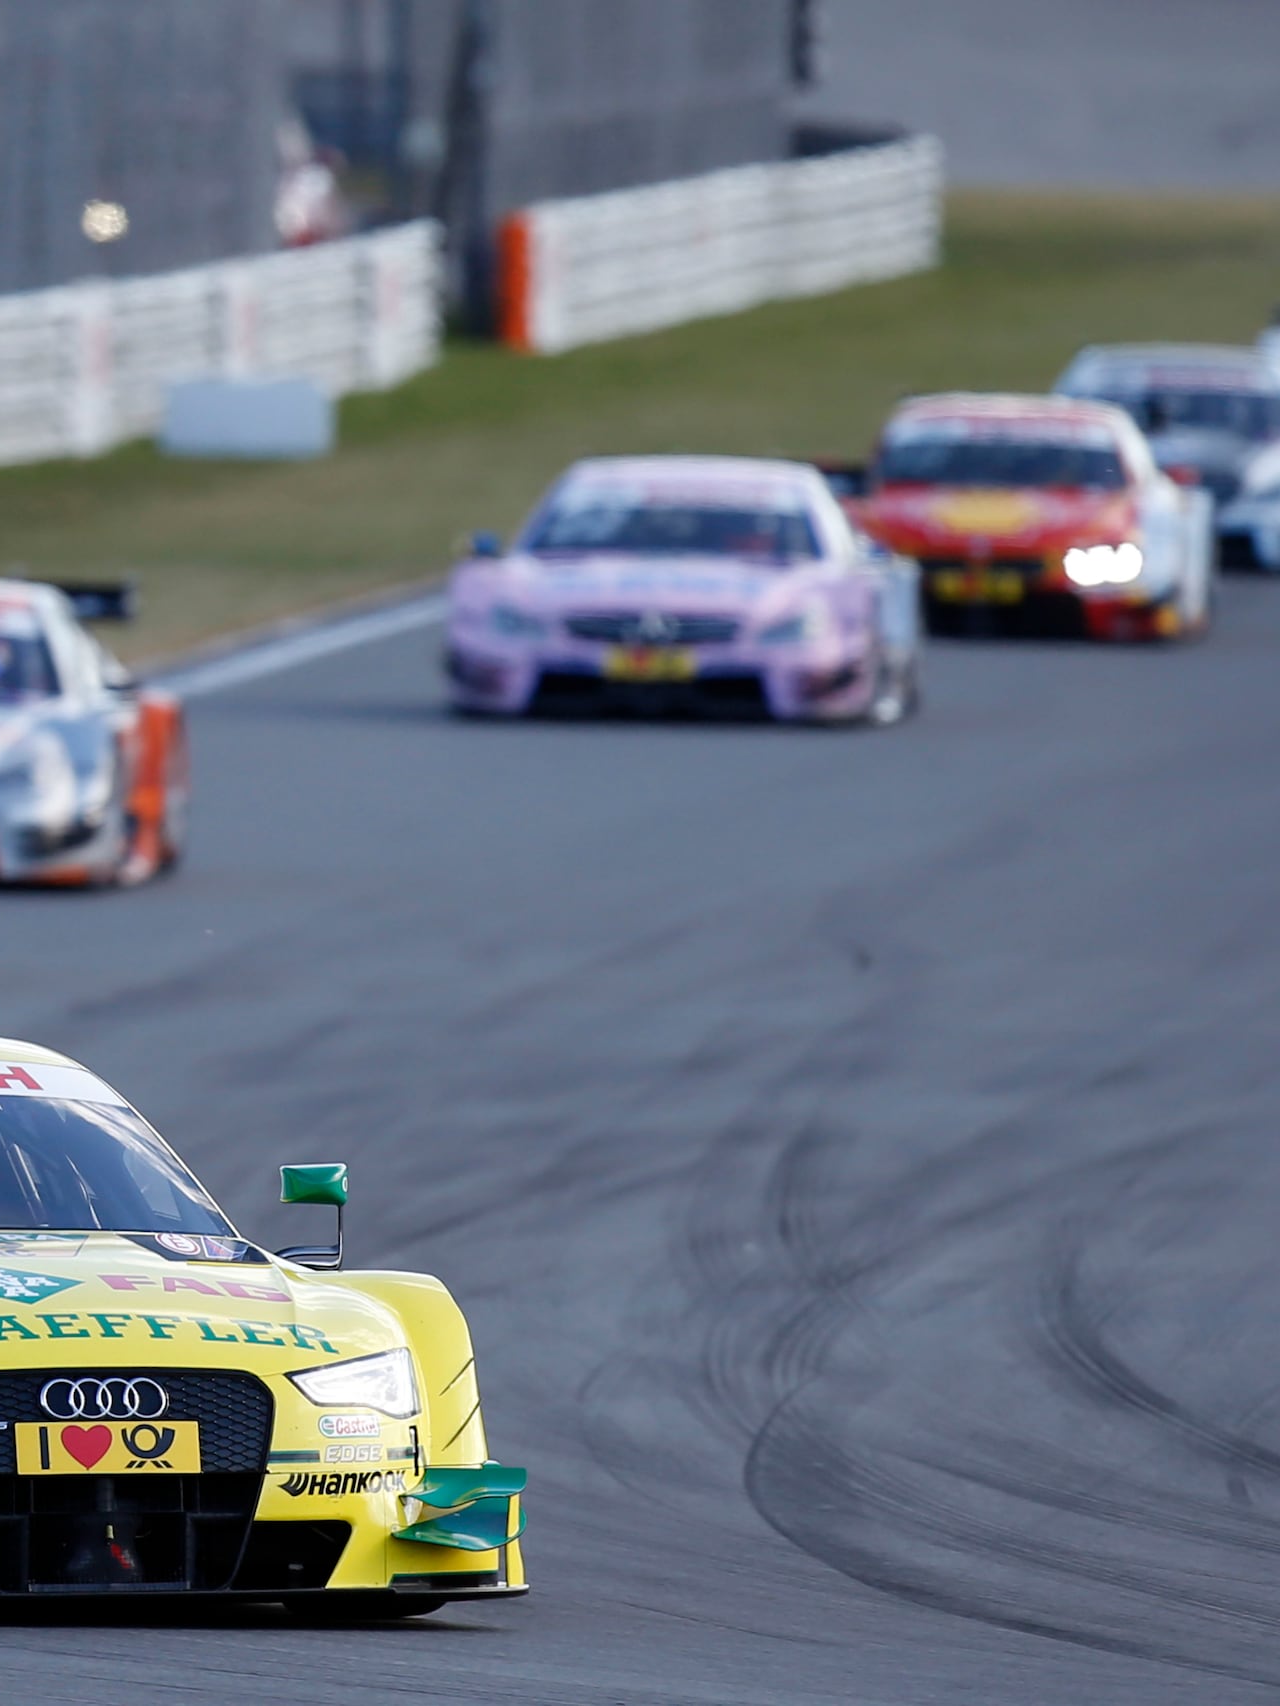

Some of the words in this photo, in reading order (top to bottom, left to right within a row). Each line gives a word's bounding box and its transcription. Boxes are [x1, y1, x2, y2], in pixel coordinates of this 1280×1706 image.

[97, 1274, 294, 1302] FAG
[39, 1426, 50, 1470] I
[323, 1444, 384, 1464] EDGE
